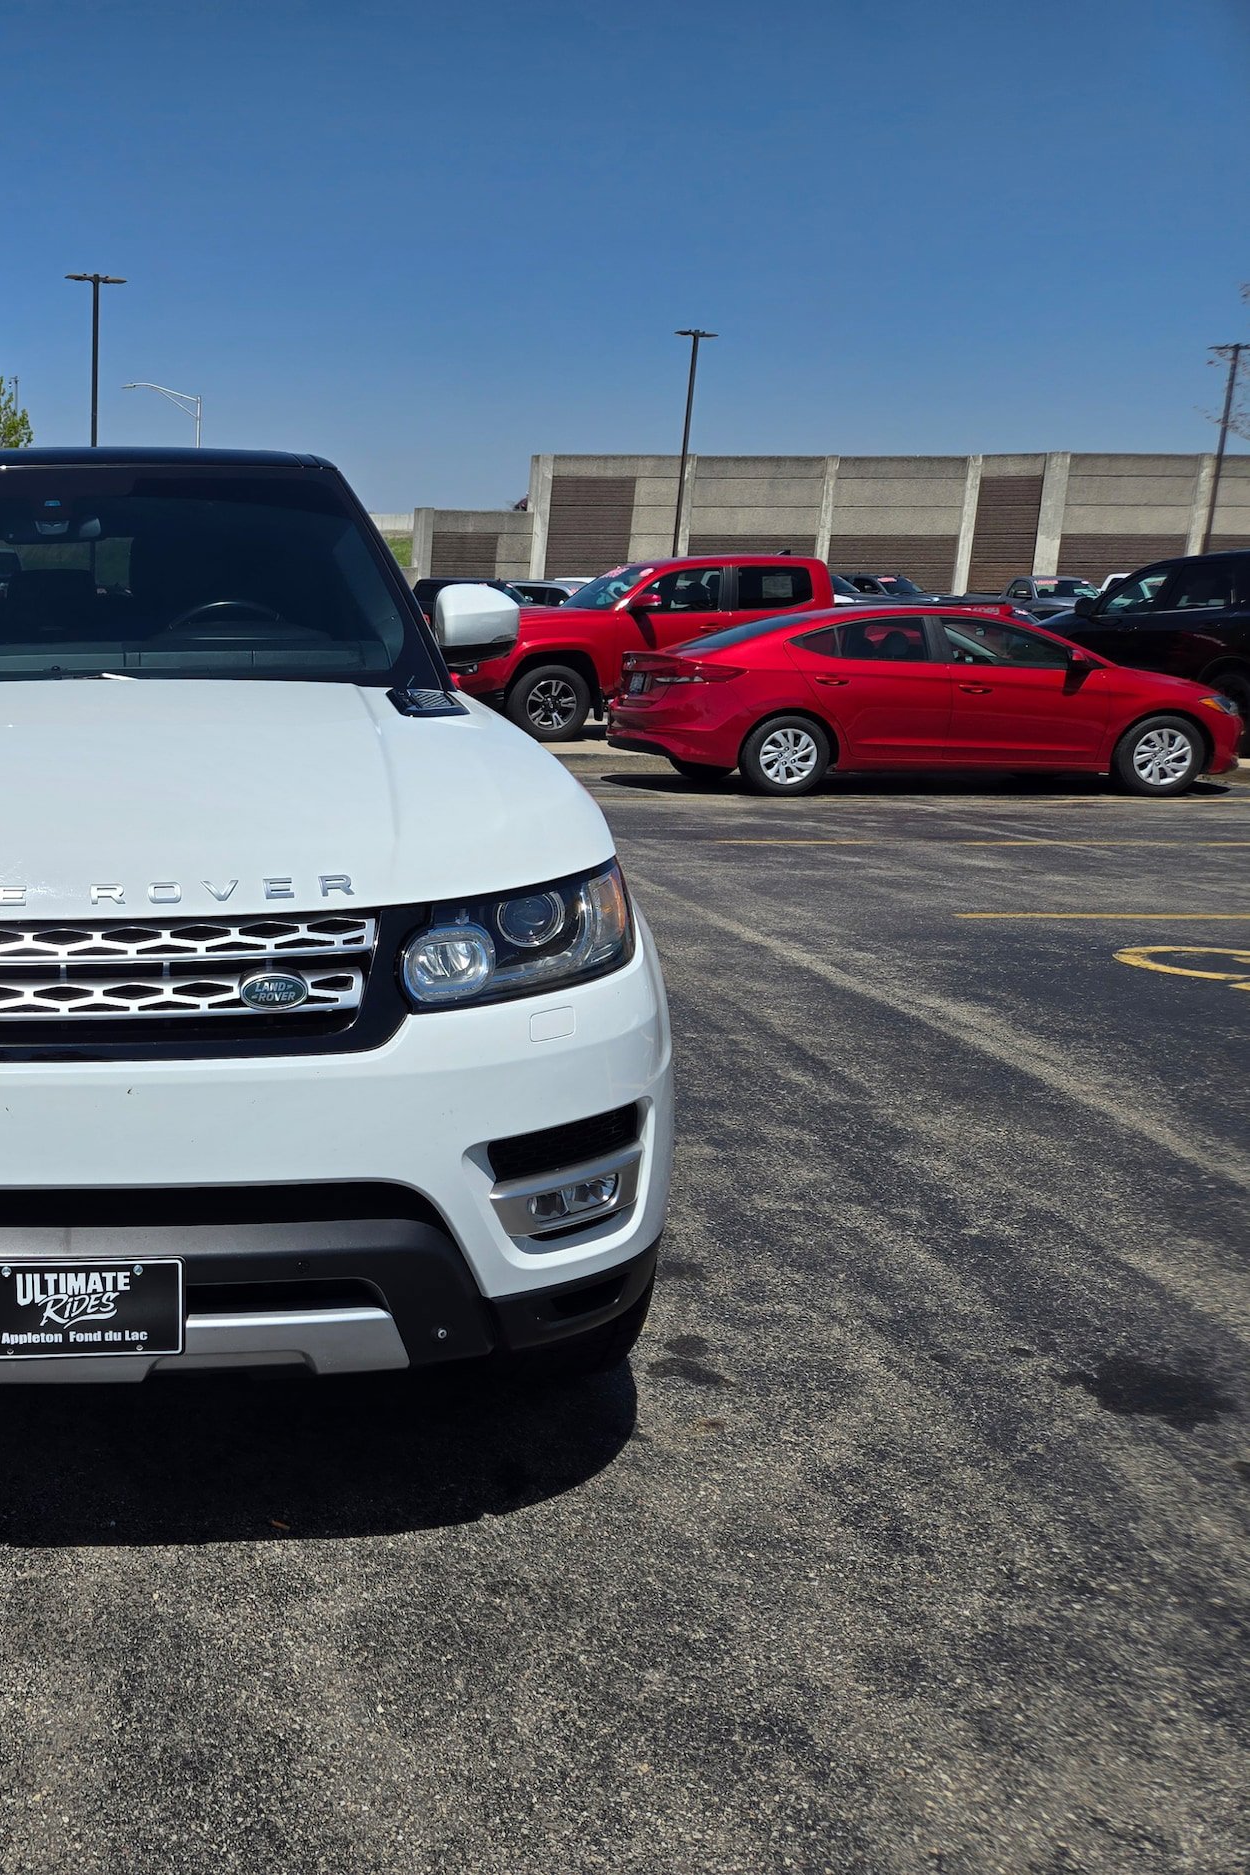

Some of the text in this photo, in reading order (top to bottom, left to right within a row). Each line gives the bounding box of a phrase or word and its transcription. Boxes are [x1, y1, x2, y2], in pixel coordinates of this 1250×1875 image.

[89, 874, 355, 905] ROVER
[255, 982, 286, 992] LAND
[258, 991, 296, 1001] ROVER
[15, 1271, 130, 1306] ULTIMATE
[1, 1330, 148, 1345] Appleton Fond du Lac
